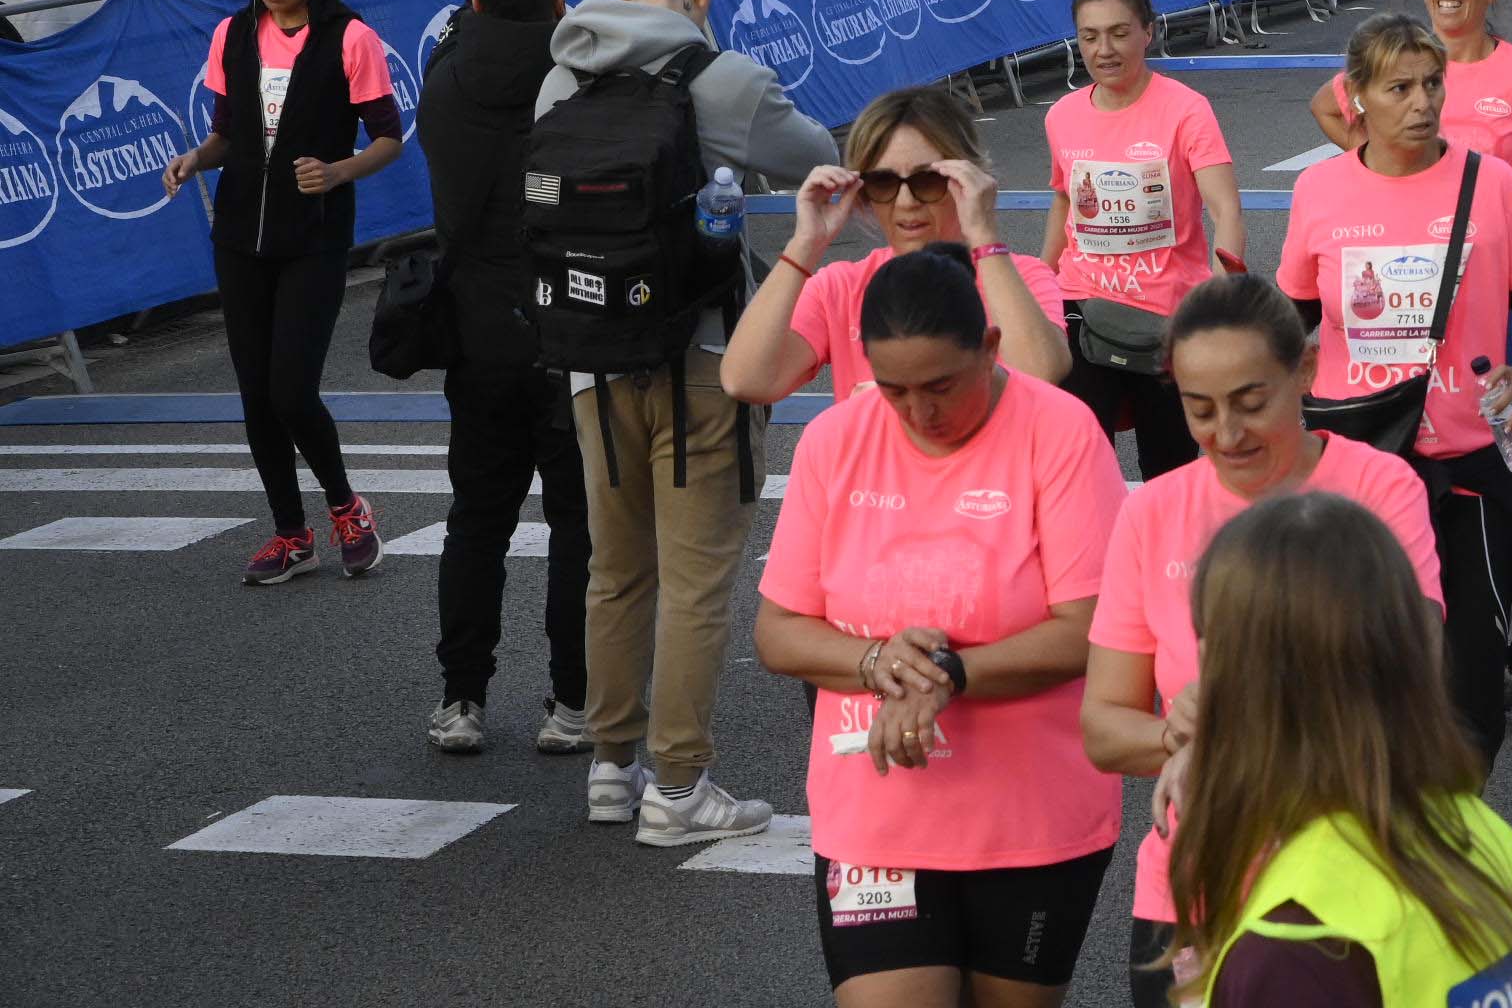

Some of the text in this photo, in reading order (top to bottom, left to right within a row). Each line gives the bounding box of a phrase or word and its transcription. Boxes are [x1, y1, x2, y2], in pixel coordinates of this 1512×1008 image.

[1102, 199, 1136, 212] 016
[1109, 216, 1130, 224] 1536
[1332, 224, 1384, 240] OYSHO
[1083, 238, 1110, 248] OYSHO
[1384, 266, 1437, 277] ASTURIANA
[1388, 292, 1433, 309] 016
[1397, 314, 1424, 324] 7718
[1360, 330, 1392, 338] CARRERA
[1358, 345, 1396, 356] OYSHO
[846, 867, 904, 886] 016
[856, 891, 892, 906] 3203
[857, 908, 917, 922] DE LA MUJE
